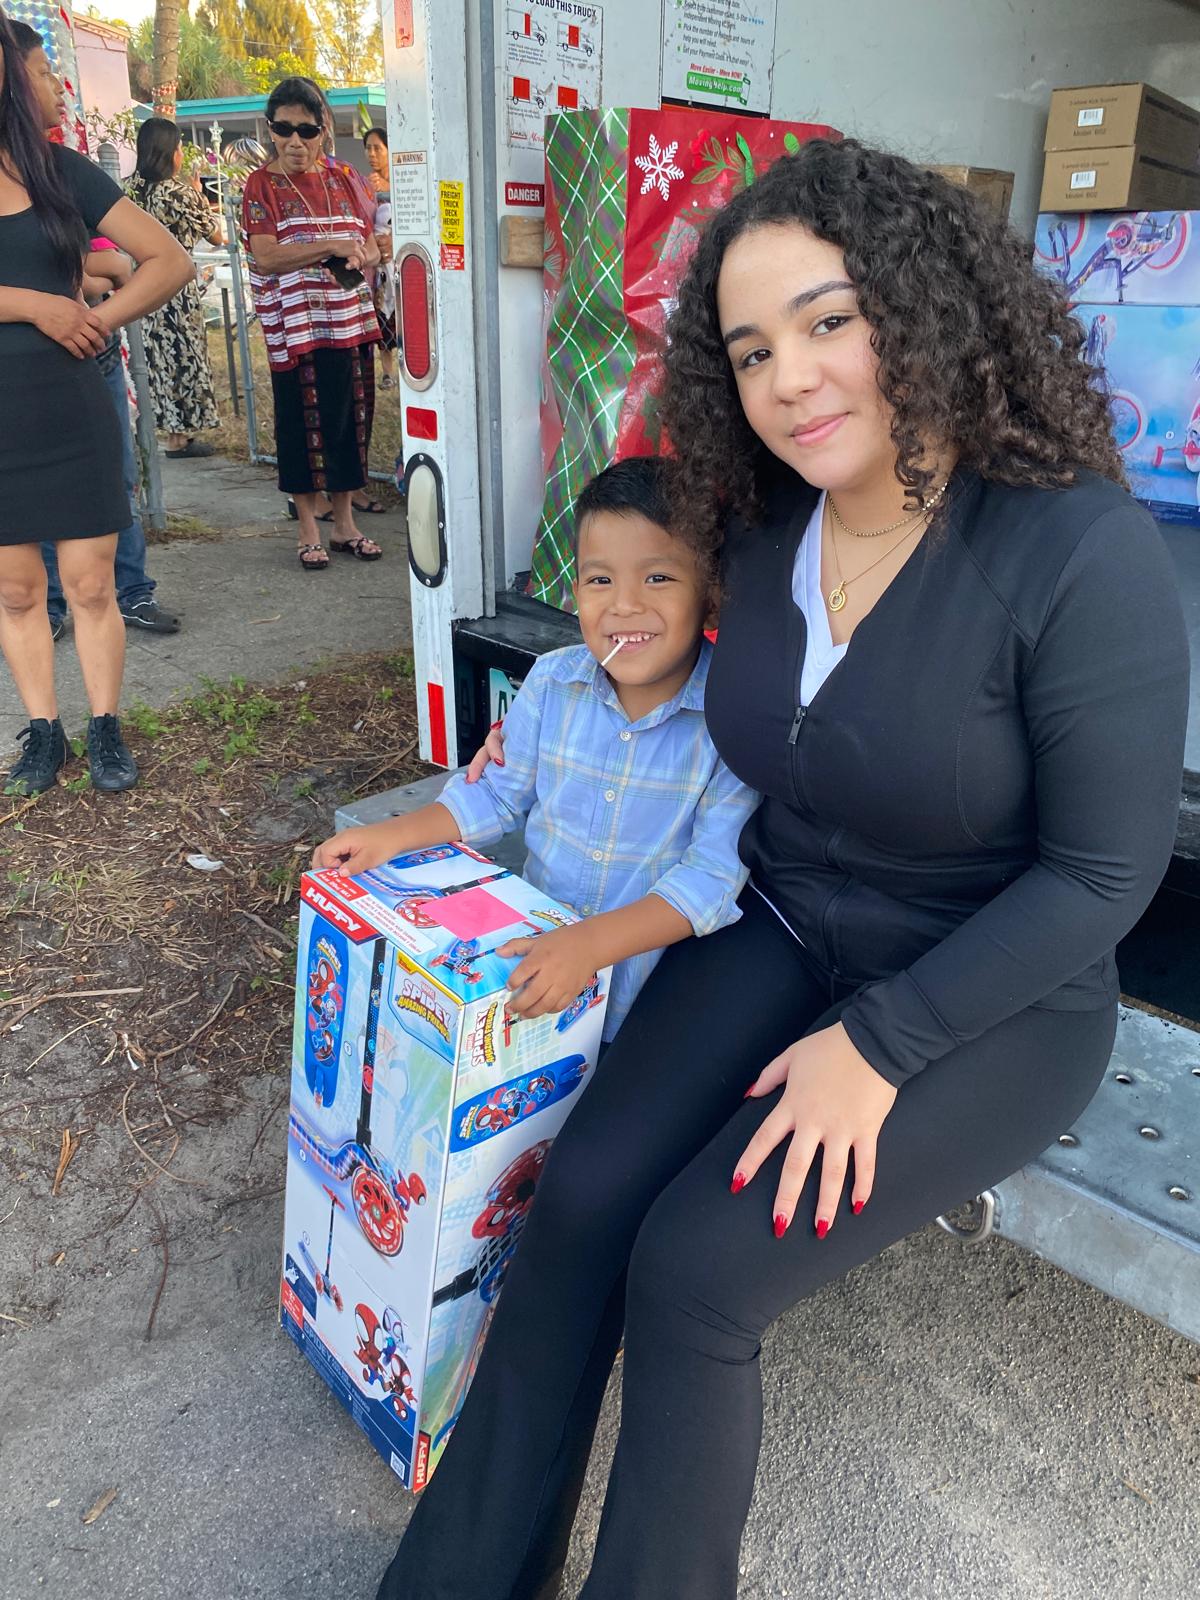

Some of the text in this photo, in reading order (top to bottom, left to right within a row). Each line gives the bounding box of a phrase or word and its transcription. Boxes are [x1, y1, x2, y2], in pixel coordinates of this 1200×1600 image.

[556, 0, 574, 13] THIS
[574, 4, 597, 18] TRUCK
[402, 152, 424, 163] WARNING
[441, 190, 460, 199] FREIGHT
[443, 199, 459, 208] TRUCK
[508, 187, 540, 202] DANGER
[443, 217, 459, 226] HEIGHT
[445, 208, 457, 217] DECK
[306, 887, 361, 932] HUFFY
[402, 979, 451, 1030] SPIDEY
[398, 995, 451, 1043] AMAZING FRIENDS
[471, 1008, 490, 1067] SPIDEY
[484, 1031, 496, 1063] AMAZING
[416, 1440, 427, 1484] HUFFY
